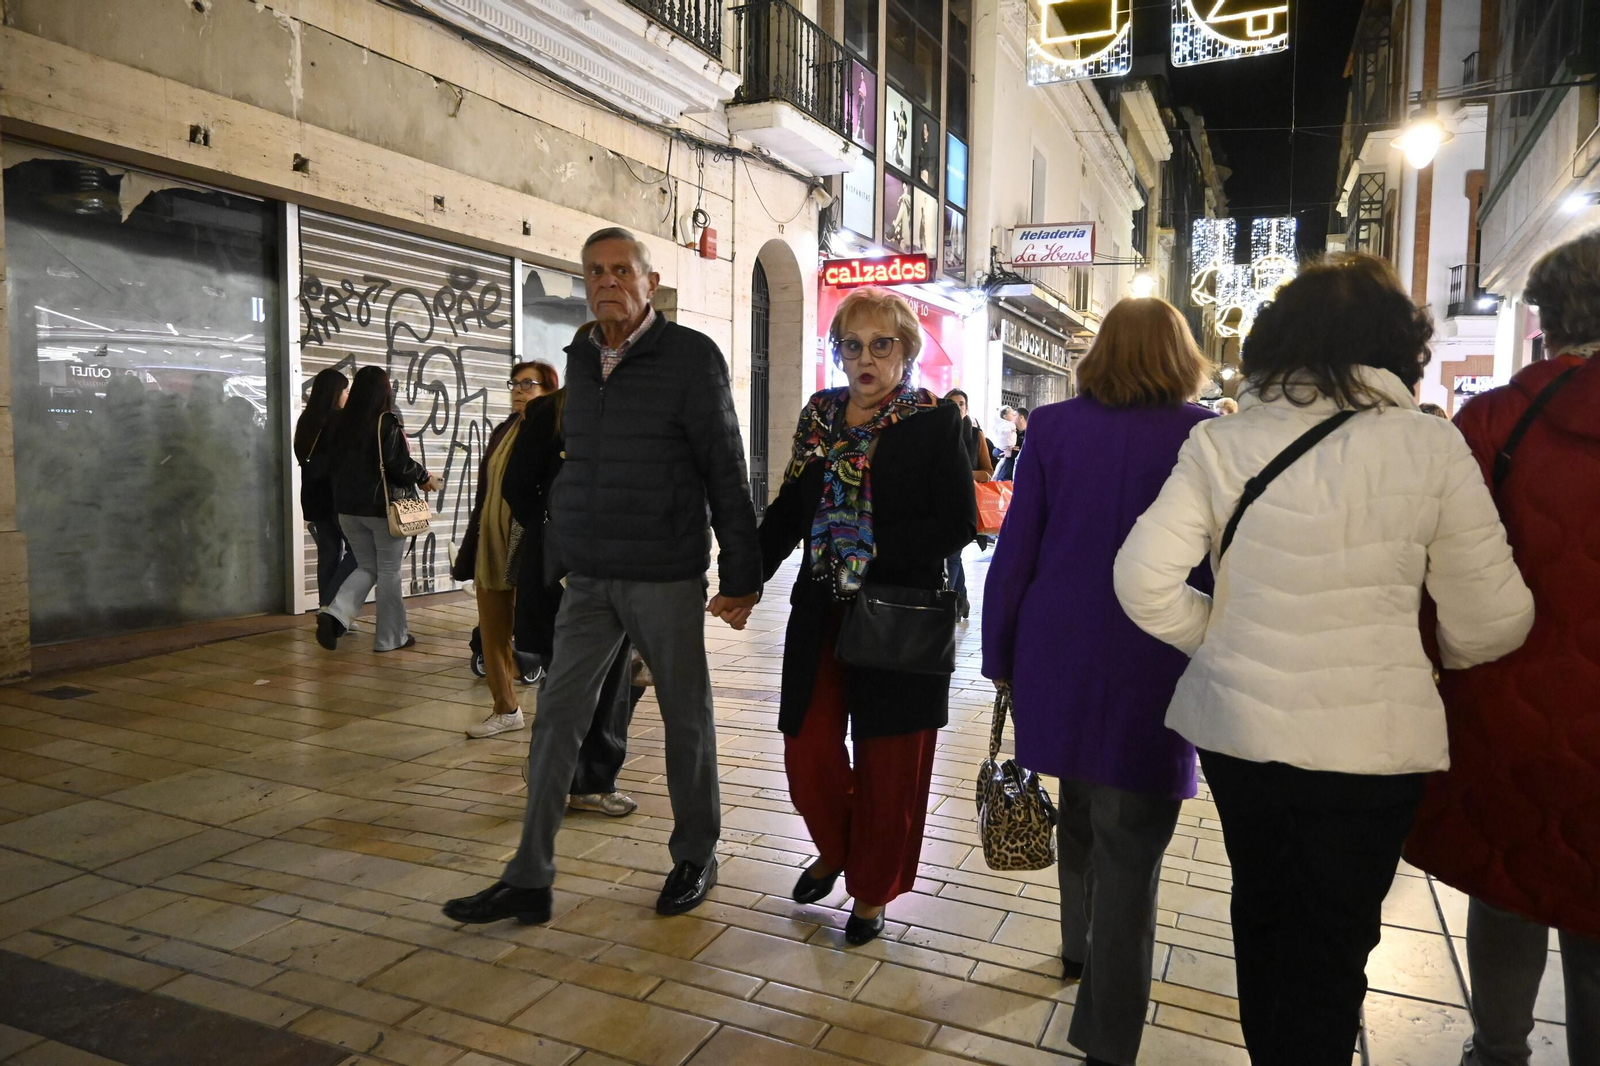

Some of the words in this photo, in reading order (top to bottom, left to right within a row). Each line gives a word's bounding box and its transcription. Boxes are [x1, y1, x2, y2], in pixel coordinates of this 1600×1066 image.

[777, 224, 785, 234] 12
[1015, 243, 1037, 263] La
[825, 257, 926, 285] calzados
[920, 303, 929, 317] 10
[1040, 338, 1050, 361] LA
